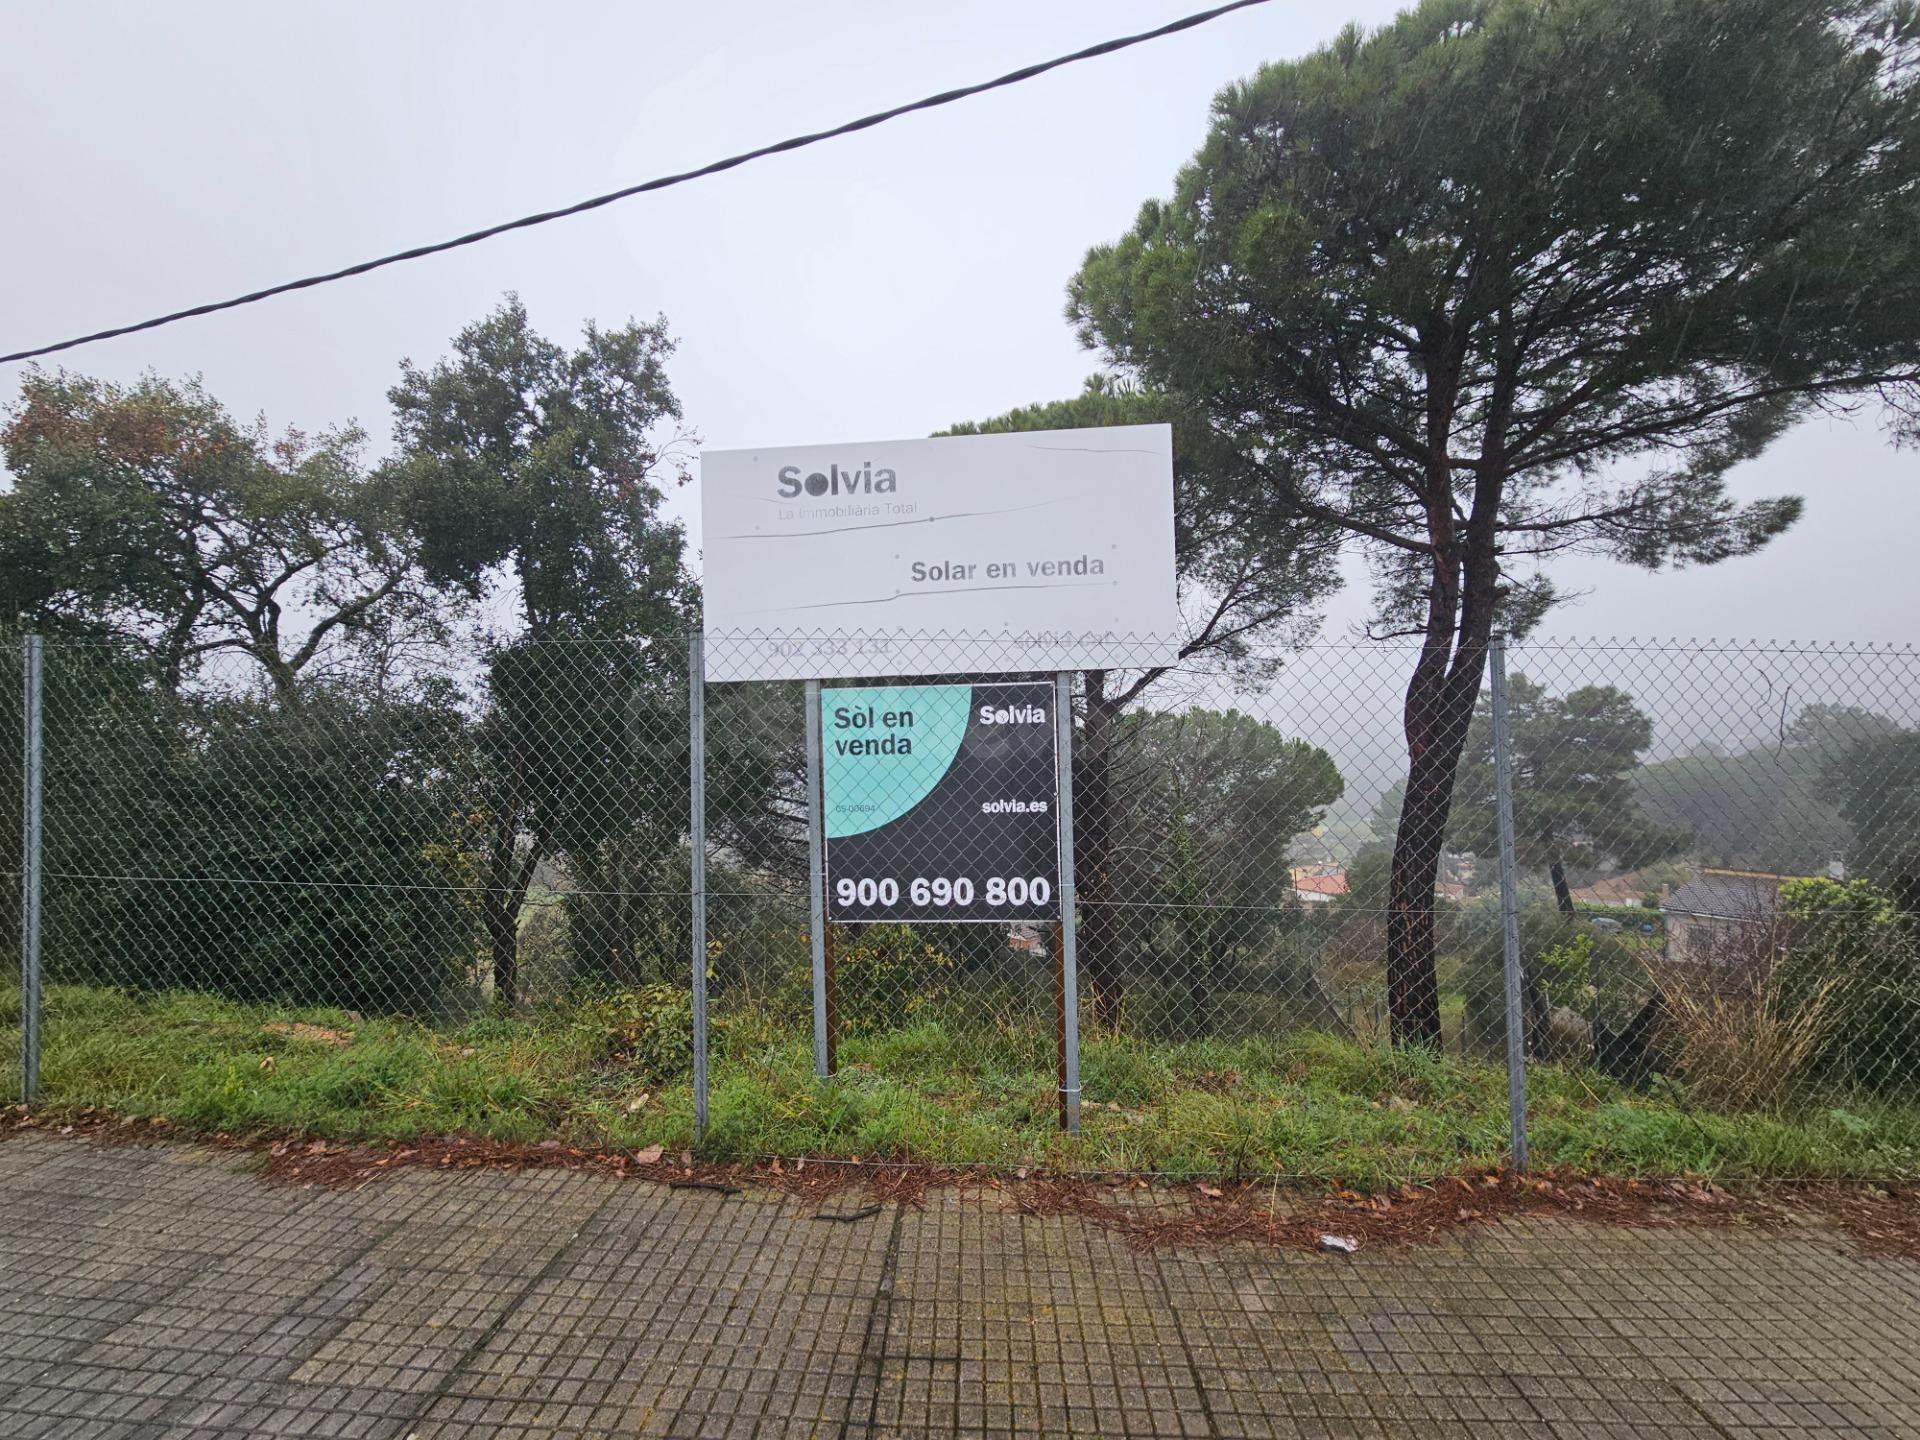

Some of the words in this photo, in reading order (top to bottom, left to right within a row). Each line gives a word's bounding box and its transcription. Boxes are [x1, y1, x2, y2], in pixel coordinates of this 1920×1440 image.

[777, 461, 897, 498] Solvia
[778, 508, 795, 521] La
[885, 502, 918, 515] Total
[911, 560, 977, 582] Solar
[986, 562, 1016, 579] en
[1026, 554, 1104, 577] venda
[834, 705, 874, 728] Sòl
[882, 711, 914, 728] en
[979, 704, 1046, 725] Solvia
[835, 733, 912, 755] venda
[982, 799, 1048, 813] solvia.es
[836, 877, 900, 907] 900
[910, 877, 975, 906] 690
[985, 876, 1051, 906] 800
